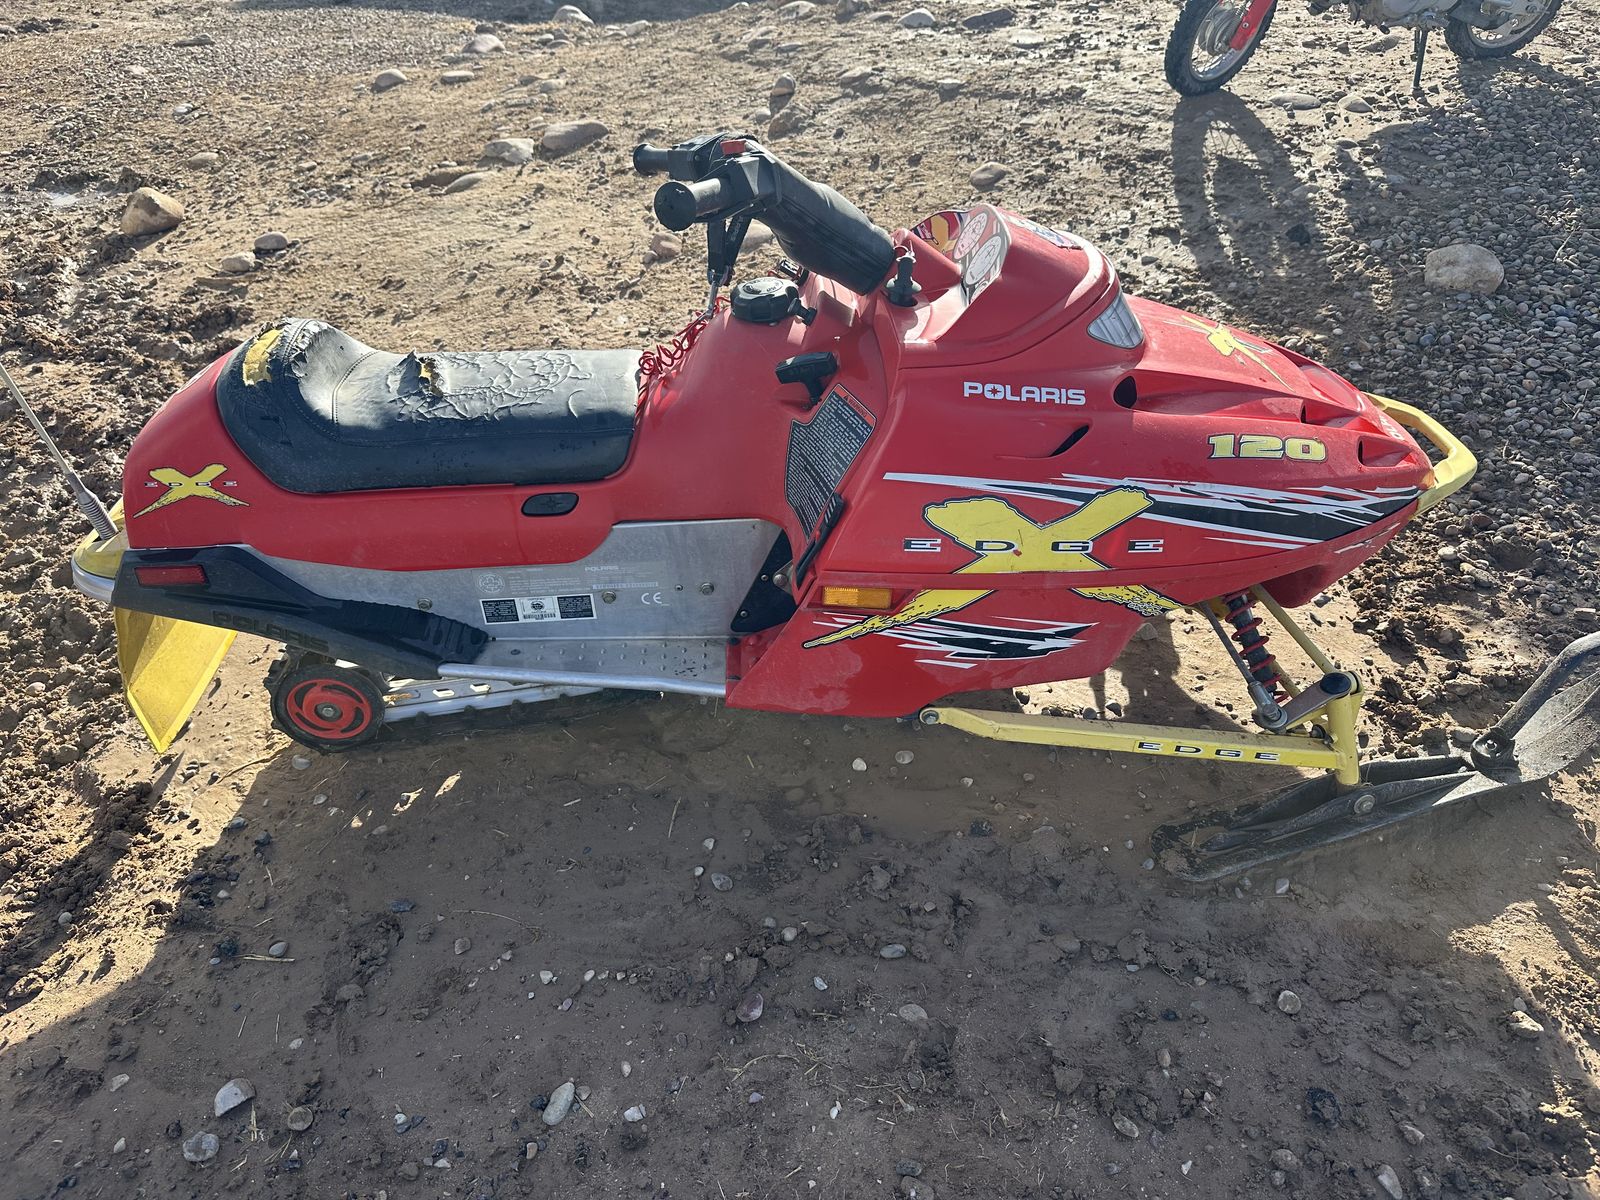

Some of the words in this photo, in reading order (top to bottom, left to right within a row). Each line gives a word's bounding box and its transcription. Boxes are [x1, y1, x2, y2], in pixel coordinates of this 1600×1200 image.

[963, 381, 1086, 406] POLARIS
[1207, 434, 1327, 462] 120
[903, 538, 1165, 553] EDGE
[212, 610, 329, 653] POLARIS
[1137, 741, 1280, 762] EDGE
